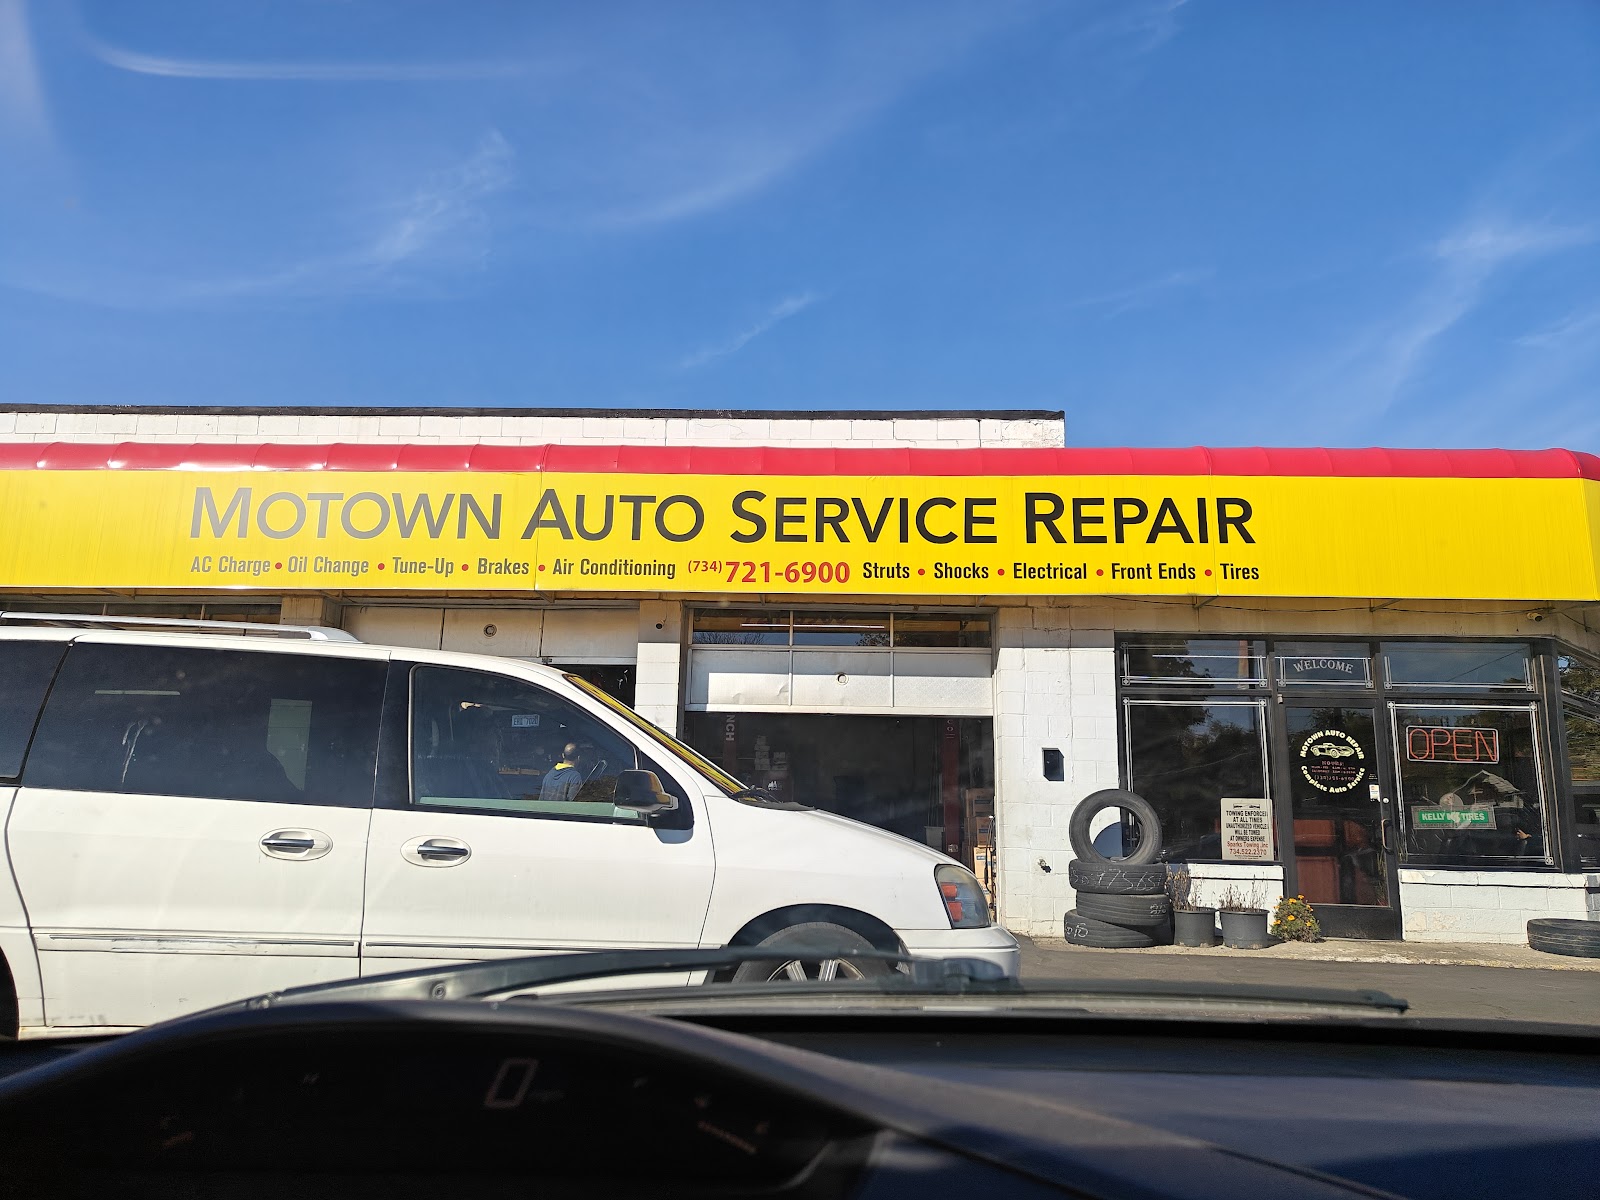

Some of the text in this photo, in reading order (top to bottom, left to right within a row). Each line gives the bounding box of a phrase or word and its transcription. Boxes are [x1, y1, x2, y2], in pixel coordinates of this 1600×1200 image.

[190, 486, 1257, 545] MOTOWN AUTO SERVICE REPAIR
[191, 555, 212, 573] AC
[218, 556, 271, 577] Charge
[288, 555, 308, 574] Oil
[313, 555, 369, 577] Change
[391, 556, 455, 578] Tune-Up
[478, 557, 530, 576] Brakes
[553, 557, 576, 576] Air
[579, 557, 677, 580] Conditioning
[862, 561, 911, 580] Struts
[933, 561, 990, 581] Shocks
[1013, 561, 1088, 581] Electrical
[1111, 562, 1154, 581] Front
[1157, 563, 1197, 582] Ends
[1220, 562, 1260, 582] Tires
[1293, 659, 1354, 673] WELCOME
[1299, 729, 1365, 760] MOTOWN AUTO REPAIR
[1409, 729, 1497, 761] OPEN
[1301, 765, 1328, 792] Complete
[1328, 786, 1348, 794] Auto
[1347, 767, 1366, 790] Service
[1421, 812, 1446, 821] KELLY
[1461, 812, 1486, 821] TIRES
